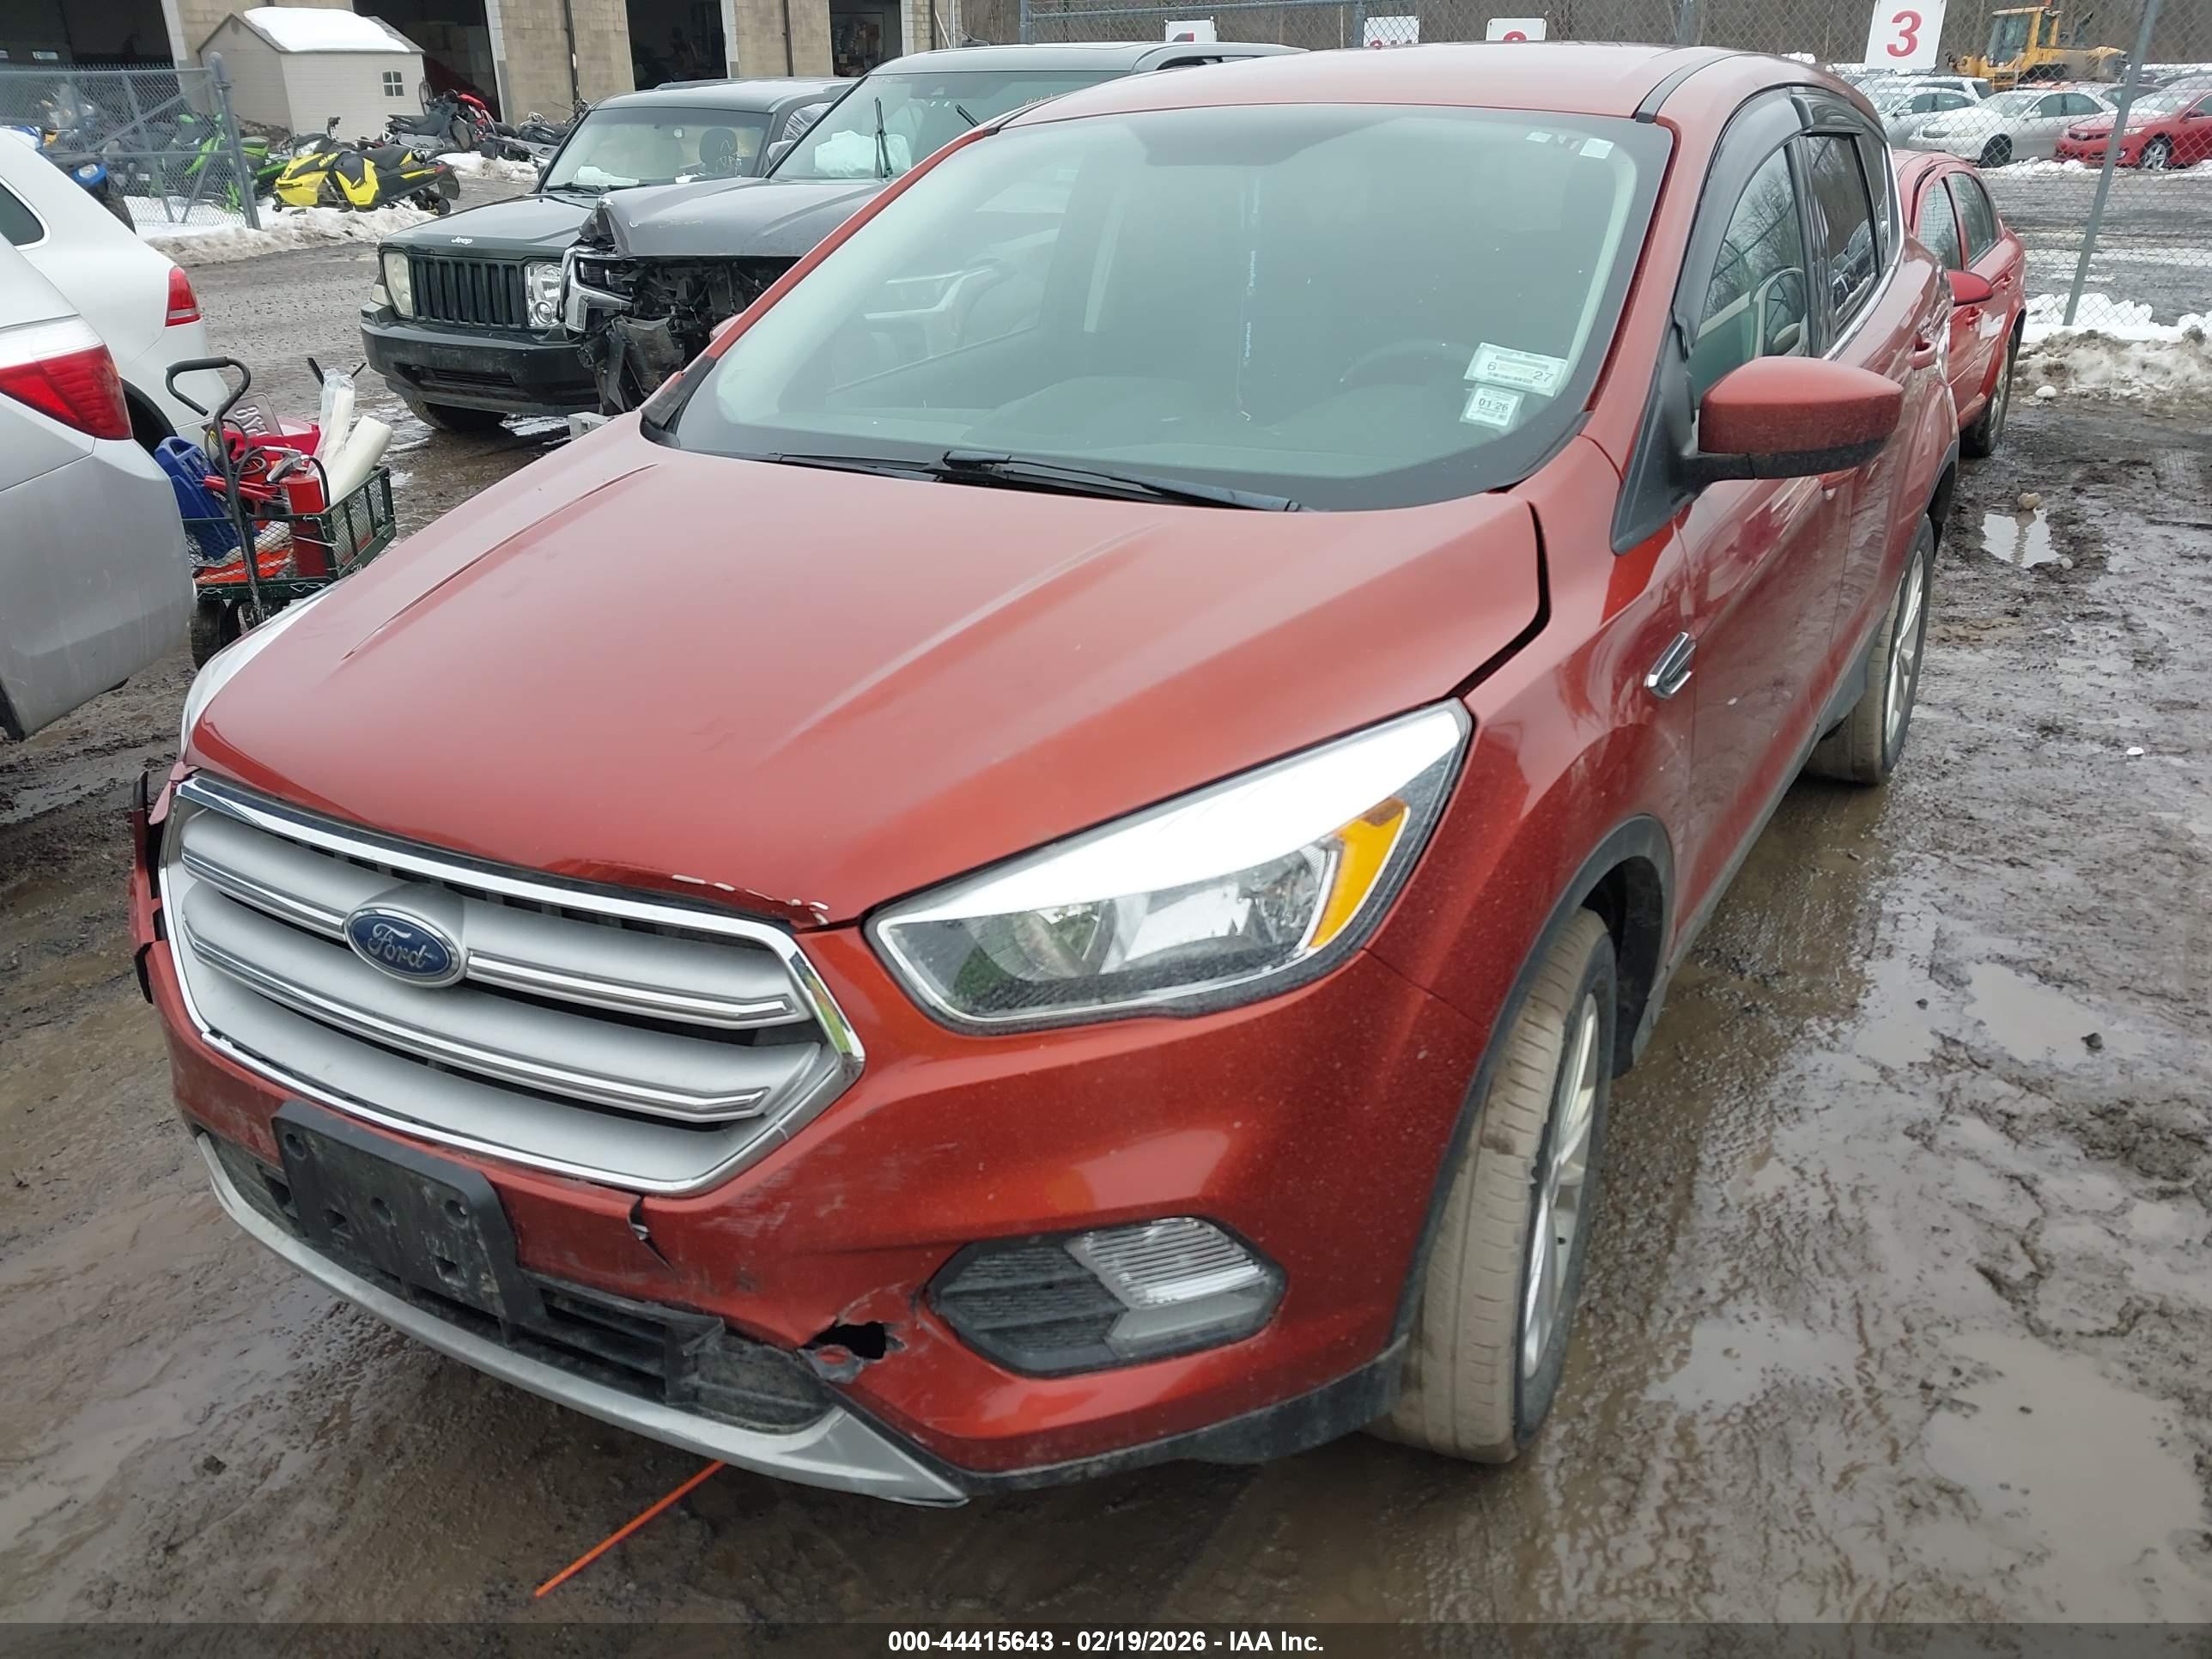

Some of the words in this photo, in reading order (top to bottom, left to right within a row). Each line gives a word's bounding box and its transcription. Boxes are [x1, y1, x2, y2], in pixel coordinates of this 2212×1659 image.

[1887, 9, 1923, 58] 3
[451, 236, 473, 246] Jeep
[1486, 361, 1498, 371] 6
[1533, 370, 1553, 383] 27
[367, 923, 438, 969] Ford
